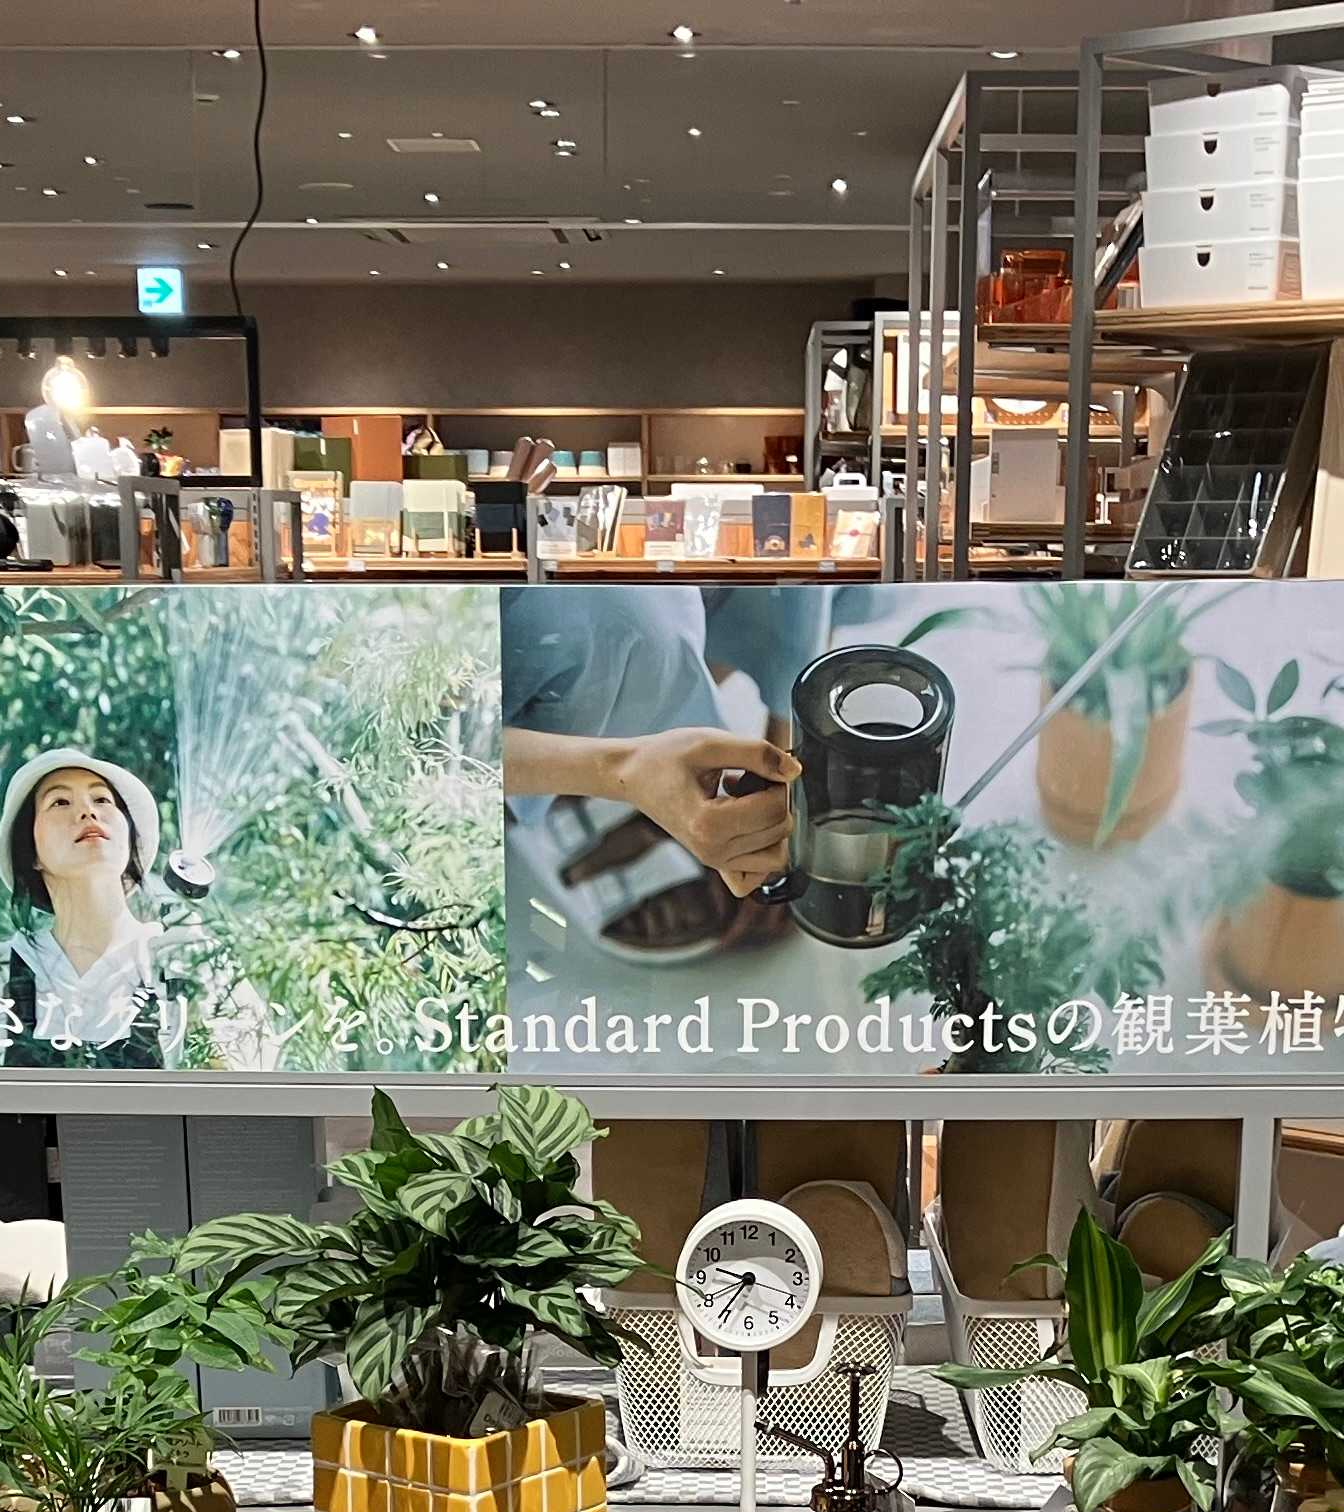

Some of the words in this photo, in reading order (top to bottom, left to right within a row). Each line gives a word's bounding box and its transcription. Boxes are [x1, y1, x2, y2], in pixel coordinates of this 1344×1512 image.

[720, 1231, 734, 1246] 11
[740, 1225, 759, 1240] 12
[768, 1232, 776, 1246] 1
[704, 1248, 721, 1262] 10
[785, 1249, 796, 1263] 2
[696, 1270, 706, 1284] 9
[792, 1271, 803, 1286] 3
[703, 1293, 713, 1307] 8
[785, 1294, 795, 1309] 4
[744, 1316, 754, 1330] 6
[768, 1311, 779, 1325] 5
